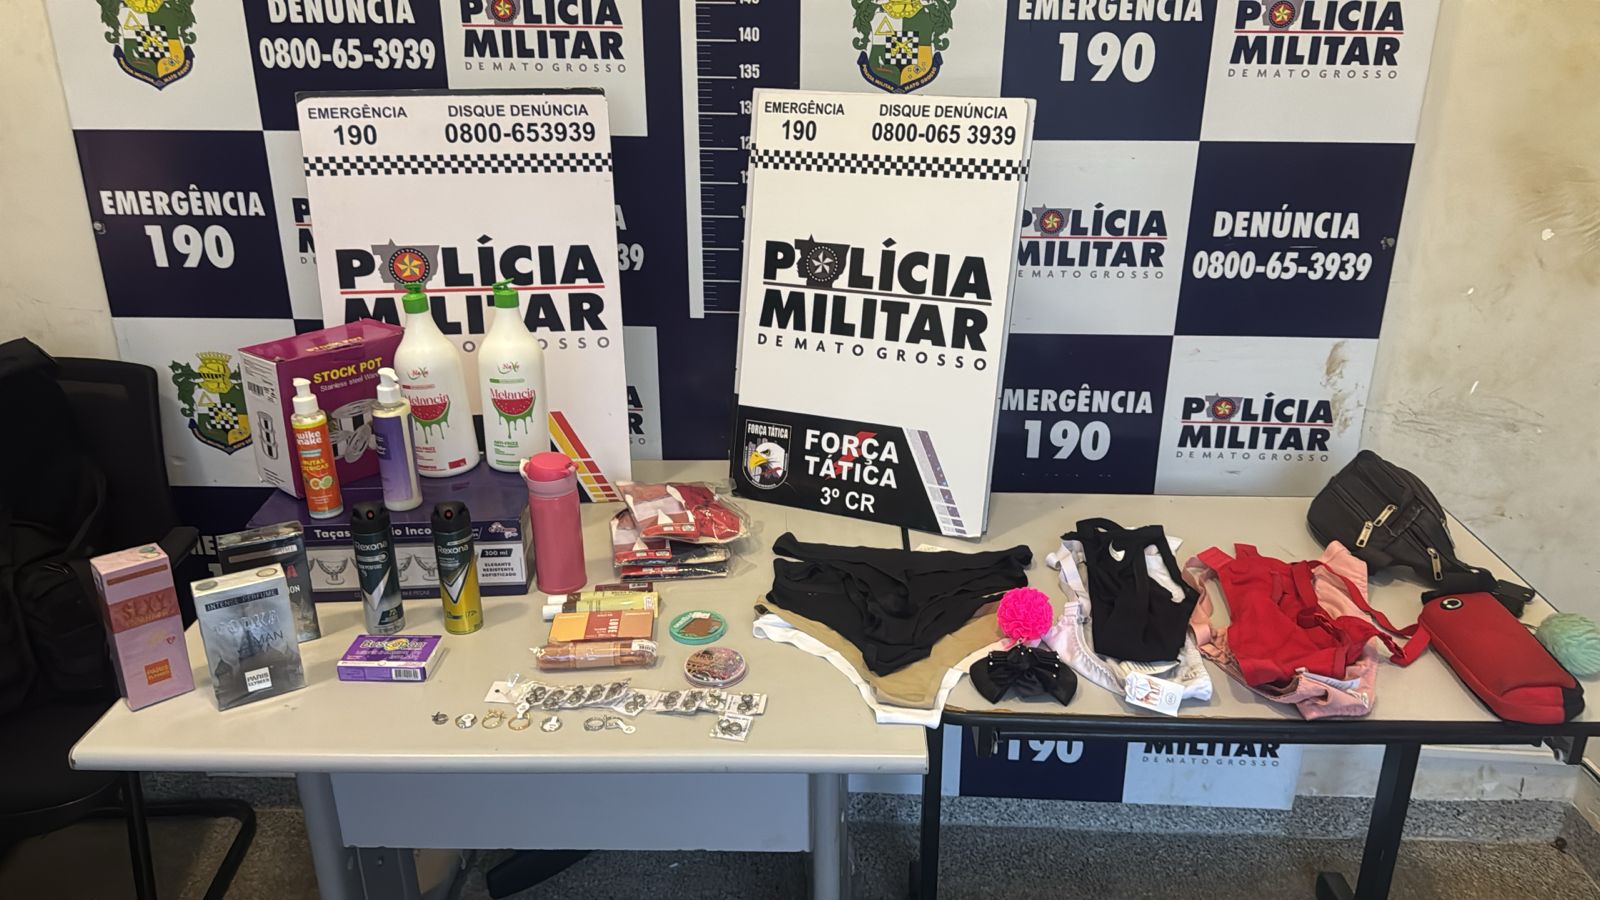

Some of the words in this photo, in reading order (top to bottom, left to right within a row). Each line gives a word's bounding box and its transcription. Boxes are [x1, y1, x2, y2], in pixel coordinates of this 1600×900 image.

[464, 29, 624, 59] MILITAR
[738, 27, 760, 42] 140
[259, 37, 436, 70] 0800-65-3939
[1059, 32, 1156, 83] 190
[1229, 36, 1401, 66] MILITAR
[739, 64, 760, 79] 135
[308, 103, 407, 119] EMERGÊNCIA
[448, 104, 506, 118] DISQUE
[510, 101, 589, 116] DENÚNCIA
[739, 100, 752, 115] 13
[764, 100, 845, 115] EMERGÊNCIA
[879, 104, 931, 118] DISQUE
[934, 103, 1008, 119] DENÚNCIA
[333, 124, 378, 145] 190
[444, 122, 596, 143] 0800-653939
[781, 120, 817, 141] 190
[872, 122, 961, 144] 0800-065
[967, 124, 1016, 146] 3939
[740, 135, 751, 150] 12
[99, 184, 266, 217] EMERGÊNCIA
[1213, 204, 1360, 240] DENÚNCIA
[144, 224, 236, 270] 190
[1192, 250, 1373, 281] 0800-65-3939
[344, 292, 608, 335] MLIAR
[759, 288, 989, 352] MILITAR
[538, 337, 610, 351] OSSO
[313, 366, 357, 385] STOCK
[360, 357, 383, 373] POT
[490, 387, 537, 400] Melancia
[1002, 383, 1153, 414] MERGÊNCIA
[748, 423, 767, 437] FORÇA
[768, 424, 788, 439] TÁTICA
[1024, 419, 1111, 461] 190
[1177, 424, 1332, 451] MILITAR
[804, 428, 899, 465] FORÇA
[804, 454, 898, 489] TÁTICA
[820, 486, 840, 505] 3º
[845, 491, 875, 513] CR
[314, 529, 351, 540] Taças
[406, 527, 432, 536] Inco
[353, 541, 388, 551] Rexona
[437, 545, 469, 554] Rexona
[243, 590, 278, 602] PERFUME
[254, 630, 284, 645] MAN
[247, 672, 269, 683] PARIS
